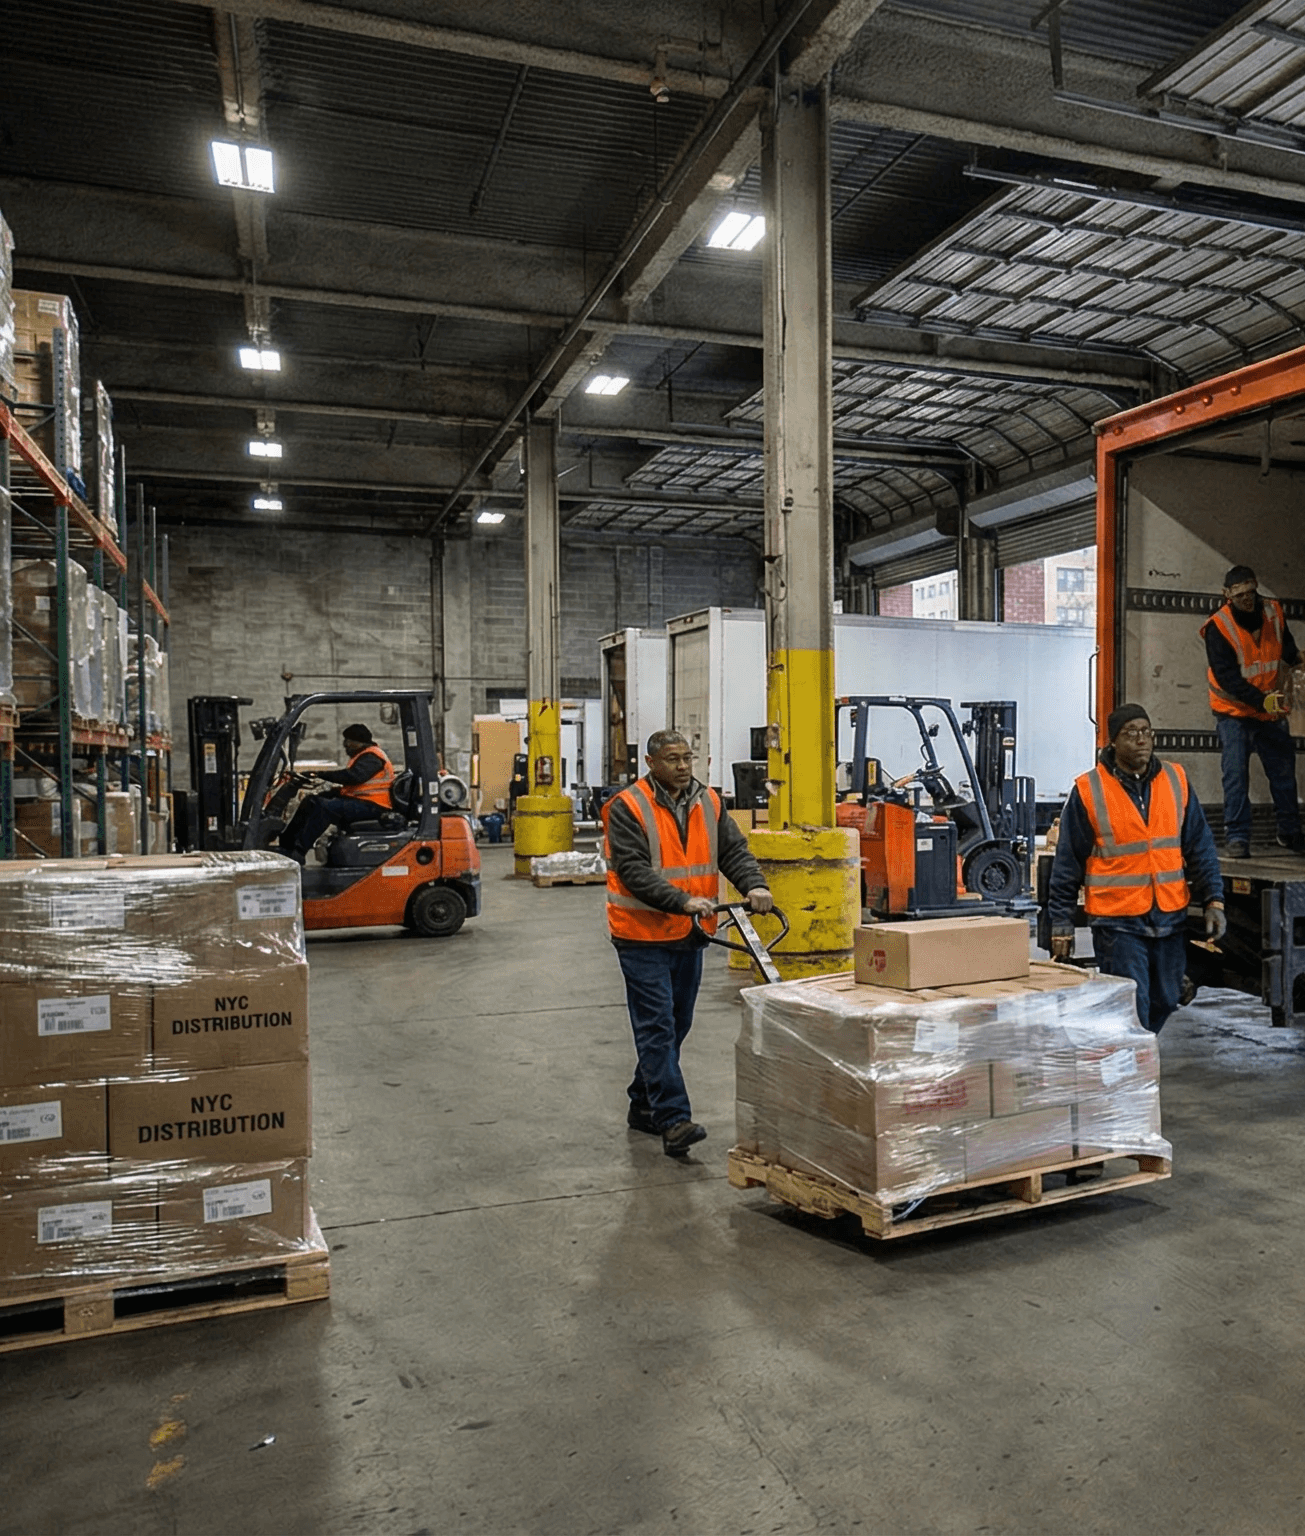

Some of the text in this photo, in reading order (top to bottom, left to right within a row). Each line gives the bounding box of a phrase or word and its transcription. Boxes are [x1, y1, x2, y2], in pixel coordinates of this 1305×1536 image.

[214, 995, 249, 1012] NYC
[171, 1011, 292, 1035] DISTRIBUTION
[190, 1093, 233, 1114] NYC
[137, 1111, 286, 1144] DISTRIBUTION
